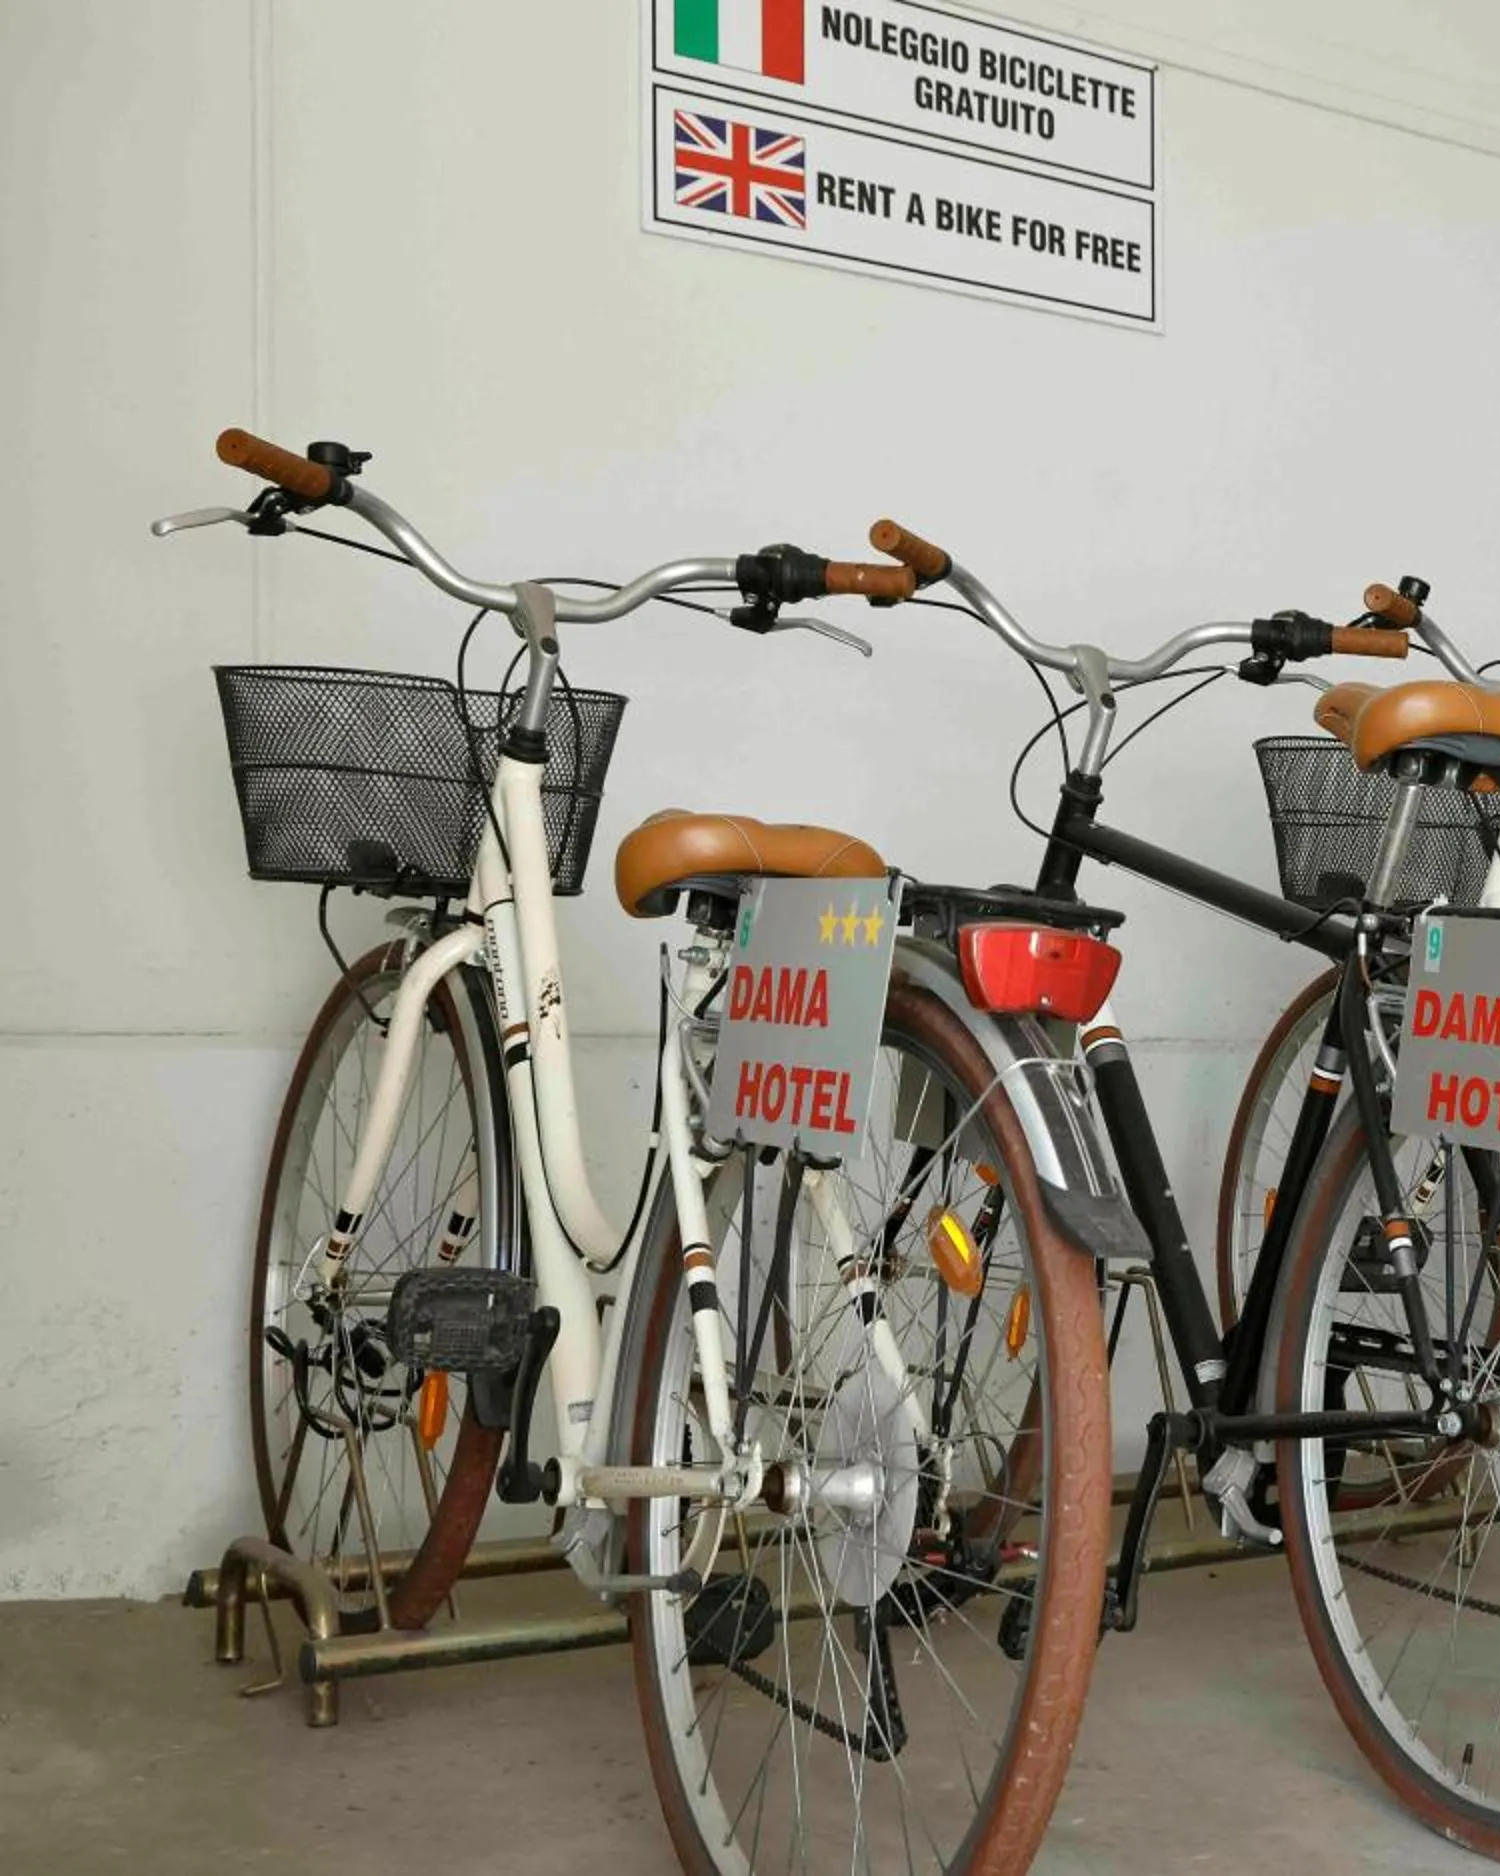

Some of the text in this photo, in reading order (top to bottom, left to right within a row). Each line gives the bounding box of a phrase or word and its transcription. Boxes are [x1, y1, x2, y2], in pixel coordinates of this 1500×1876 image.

[821, 5, 1137, 120] NOLEGGIO BICICLETTE
[914, 76, 1056, 141] GRATUITO
[816, 172, 1142, 273] RENT A BIKE FOR FREE
[1428, 931, 1442, 960] 9
[729, 965, 830, 1028] DAMA
[735, 1060, 857, 1134] HOTEL
